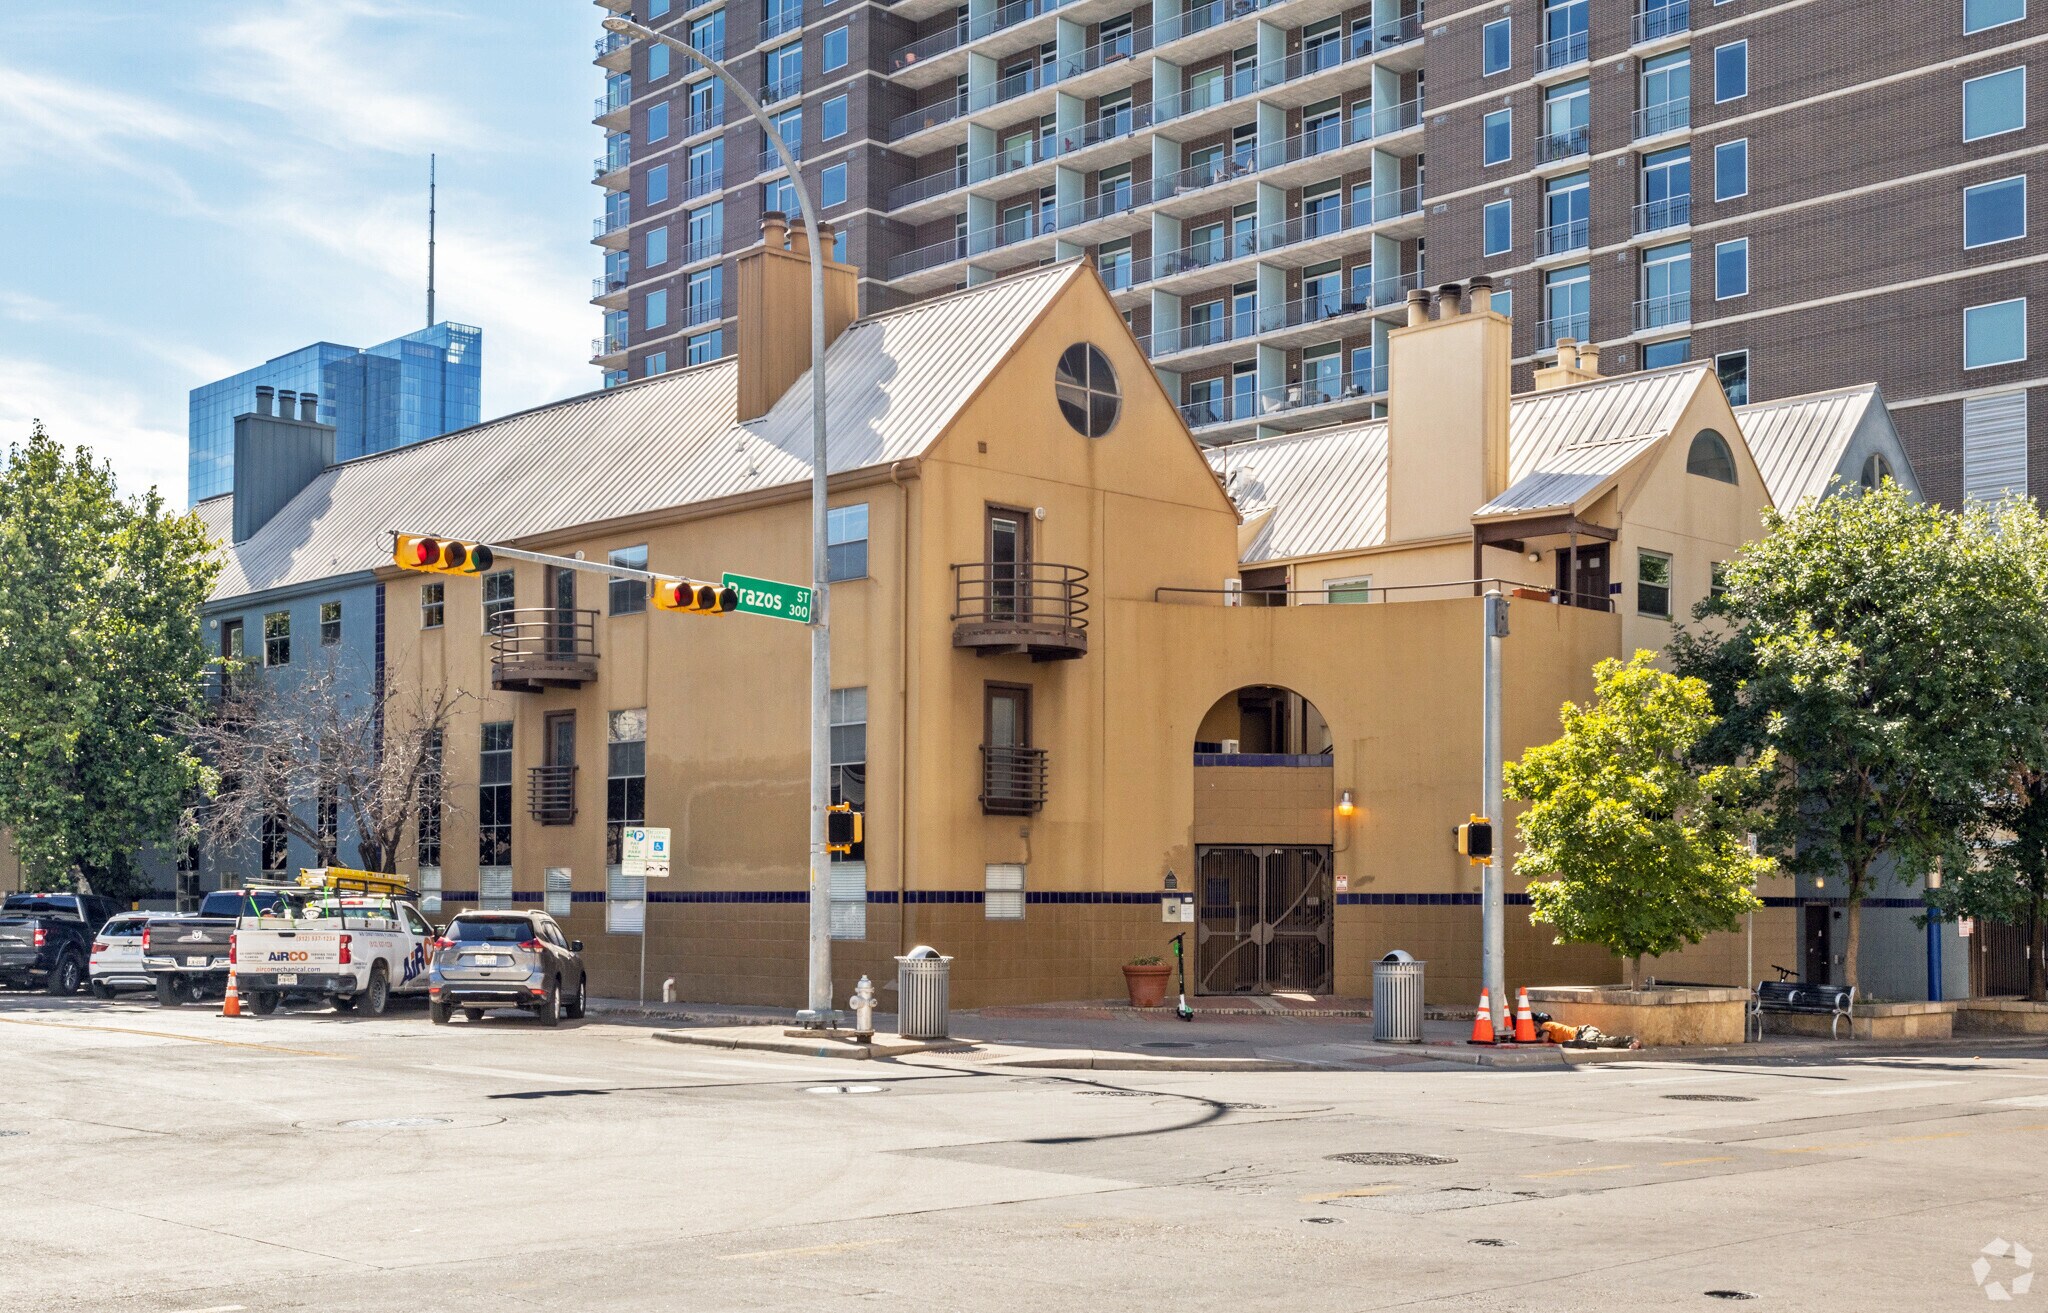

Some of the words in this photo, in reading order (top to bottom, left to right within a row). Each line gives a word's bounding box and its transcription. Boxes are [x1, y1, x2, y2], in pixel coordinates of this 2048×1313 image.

[797, 591, 809, 603] ST
[789, 604, 808, 618] 300
[268, 951, 308, 962] AiRCO
[400, 937, 434, 986] AiRC
